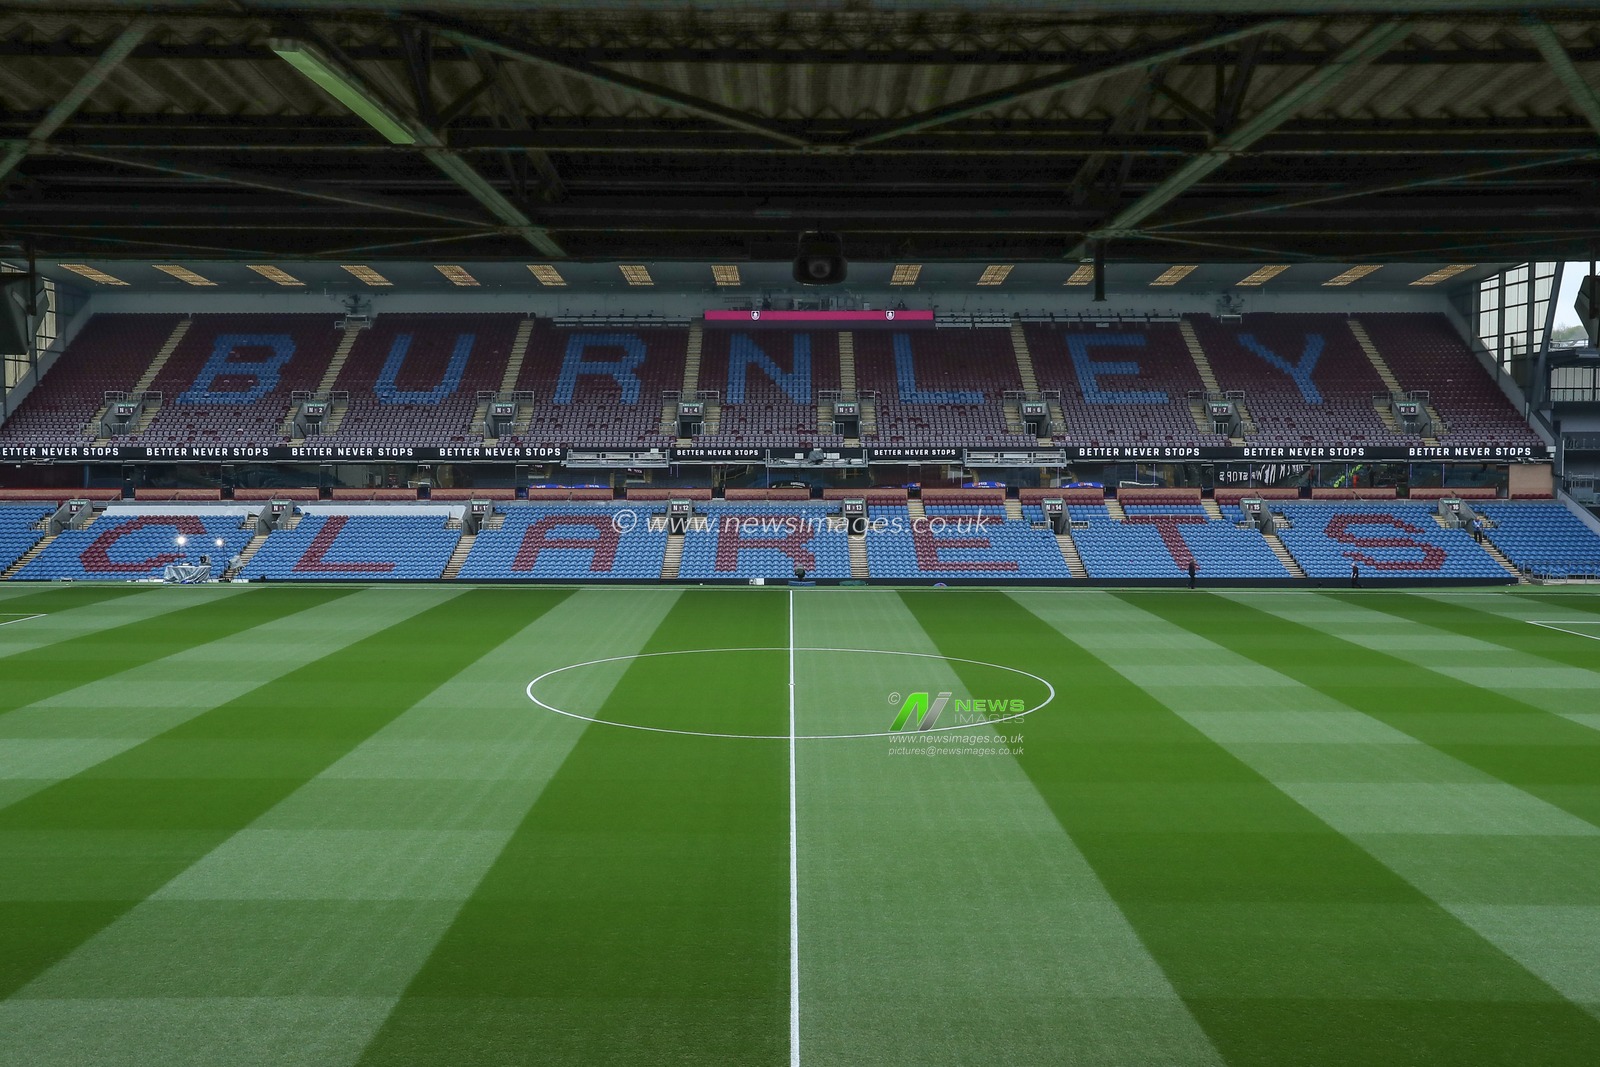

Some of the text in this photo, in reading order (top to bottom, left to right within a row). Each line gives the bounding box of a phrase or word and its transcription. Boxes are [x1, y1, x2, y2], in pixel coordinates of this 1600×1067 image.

[176, 332, 1325, 405] BURNLEY
[42, 447, 77, 456] NEVER
[84, 447, 118, 456] STOPS
[147, 447, 268, 456] BETTER NEVER STOPS
[292, 447, 412, 456] BETTER NEVER STOPS
[440, 447, 560, 456] BETTER NEVER STOPS
[1080, 447, 1199, 456] BETTER NEVER STOPS
[1244, 447, 1364, 456] BETTER NEVER STOPS
[1410, 447, 1531, 456] BETTER NEVER STOPS
[80, 515, 1447, 573] CLARETS
